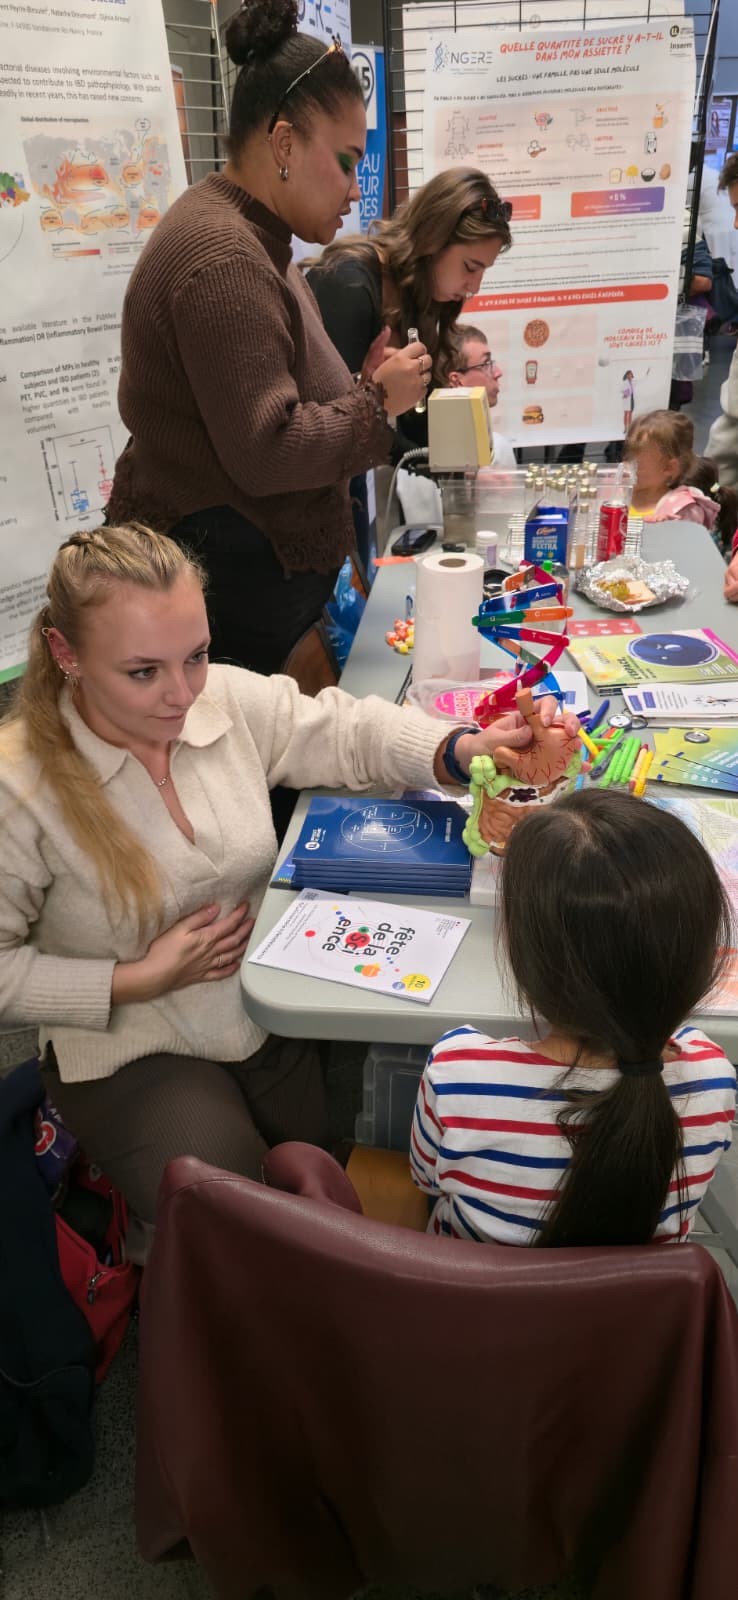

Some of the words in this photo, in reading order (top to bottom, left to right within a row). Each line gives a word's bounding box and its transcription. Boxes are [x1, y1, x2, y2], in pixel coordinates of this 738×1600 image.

[500, 42, 535, 54] QUELLE
[537, 38, 582, 51] QUANTITÉ
[584, 37, 596, 47] DE
[597, 35, 624, 46] SUCRE
[626, 34, 634, 44] Y
[635, 32, 664, 44] A-T-IL
[536, 50, 558, 62] DANS
[560, 48, 581, 60] MON
[582, 46, 622, 58] ASSIETTE
[624, 44, 631, 54] ?
[361, 152, 380, 174] AU
[20, 367, 54, 379] Comparison
[81, 359, 100, 369] healthy
[24, 379, 47, 390] subjects
[48, 377, 59, 386] and
[70, 372, 91, 382] patients
[49, 388, 60, 396] and
[322, 918, 351, 951] ence
[373, 922, 393, 940] de
[386, 926, 416, 956] fête
[341, 932, 368, 955] Sci
[363, 943, 385, 956] la
